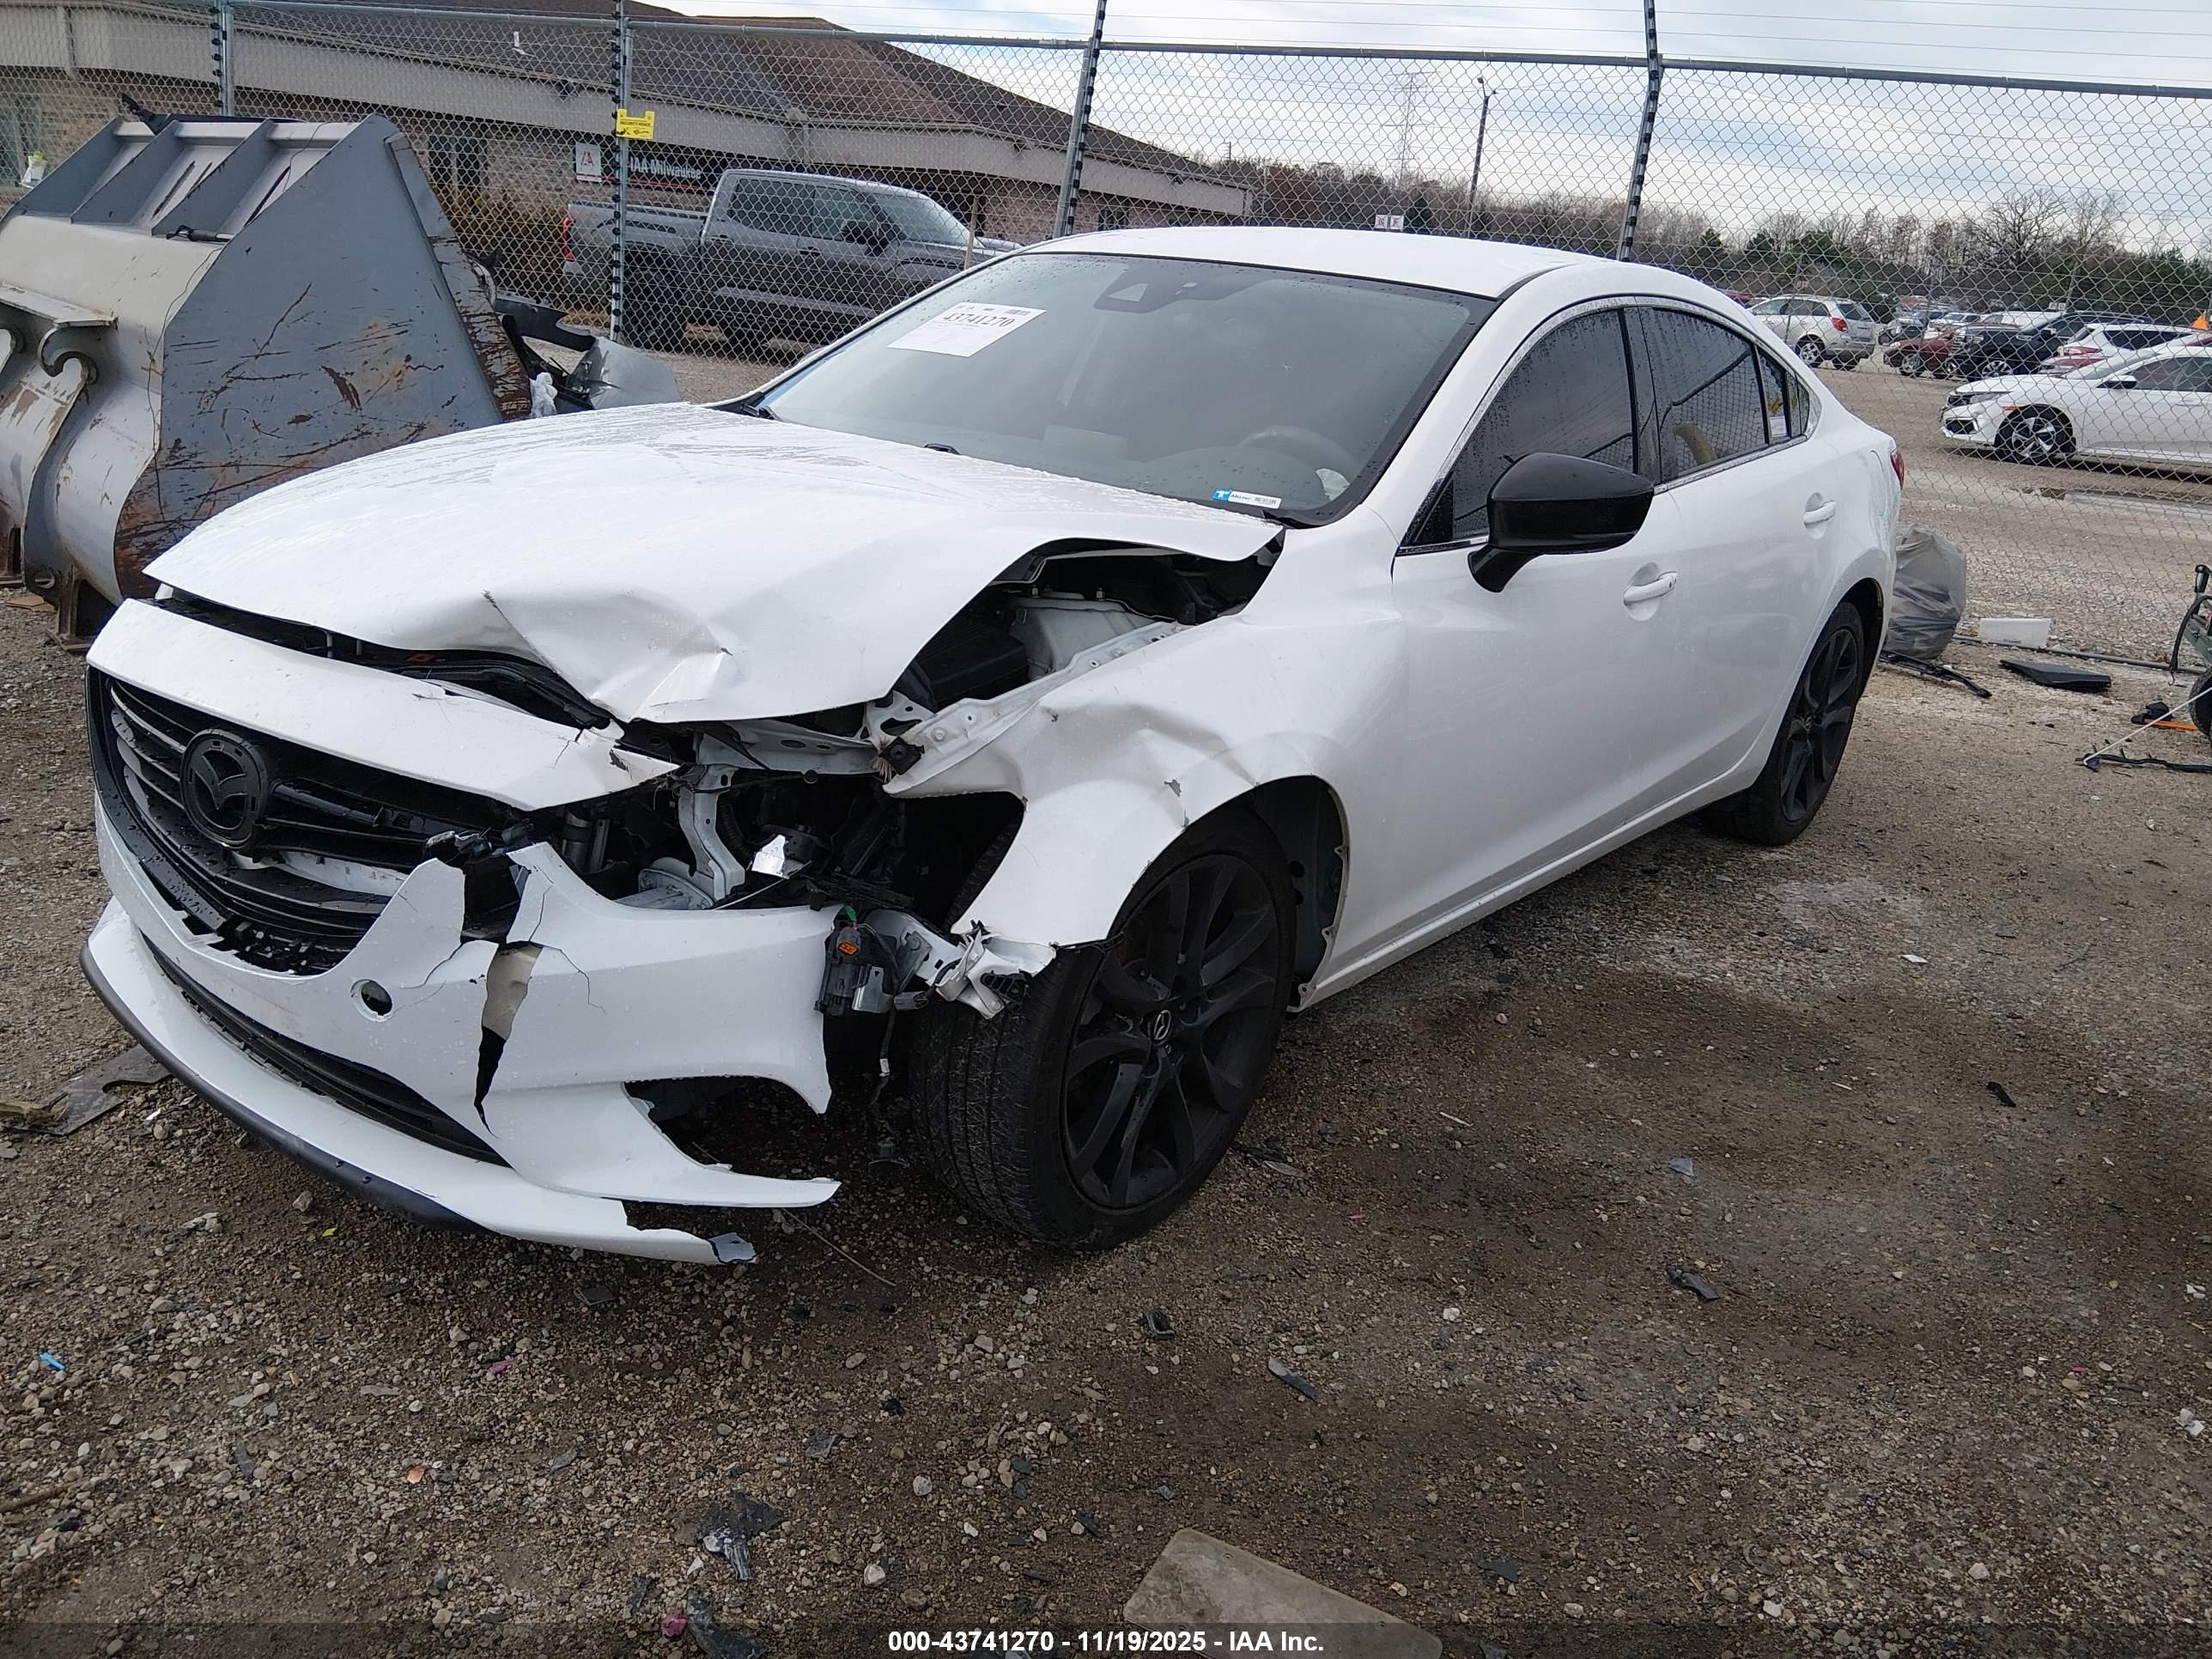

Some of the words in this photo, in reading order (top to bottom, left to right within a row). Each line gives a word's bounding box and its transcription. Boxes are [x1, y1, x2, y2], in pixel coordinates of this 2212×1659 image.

[630, 157, 648, 173] IAA
[651, 160, 702, 179] Milwaukee
[943, 313, 1015, 327] 43741270
